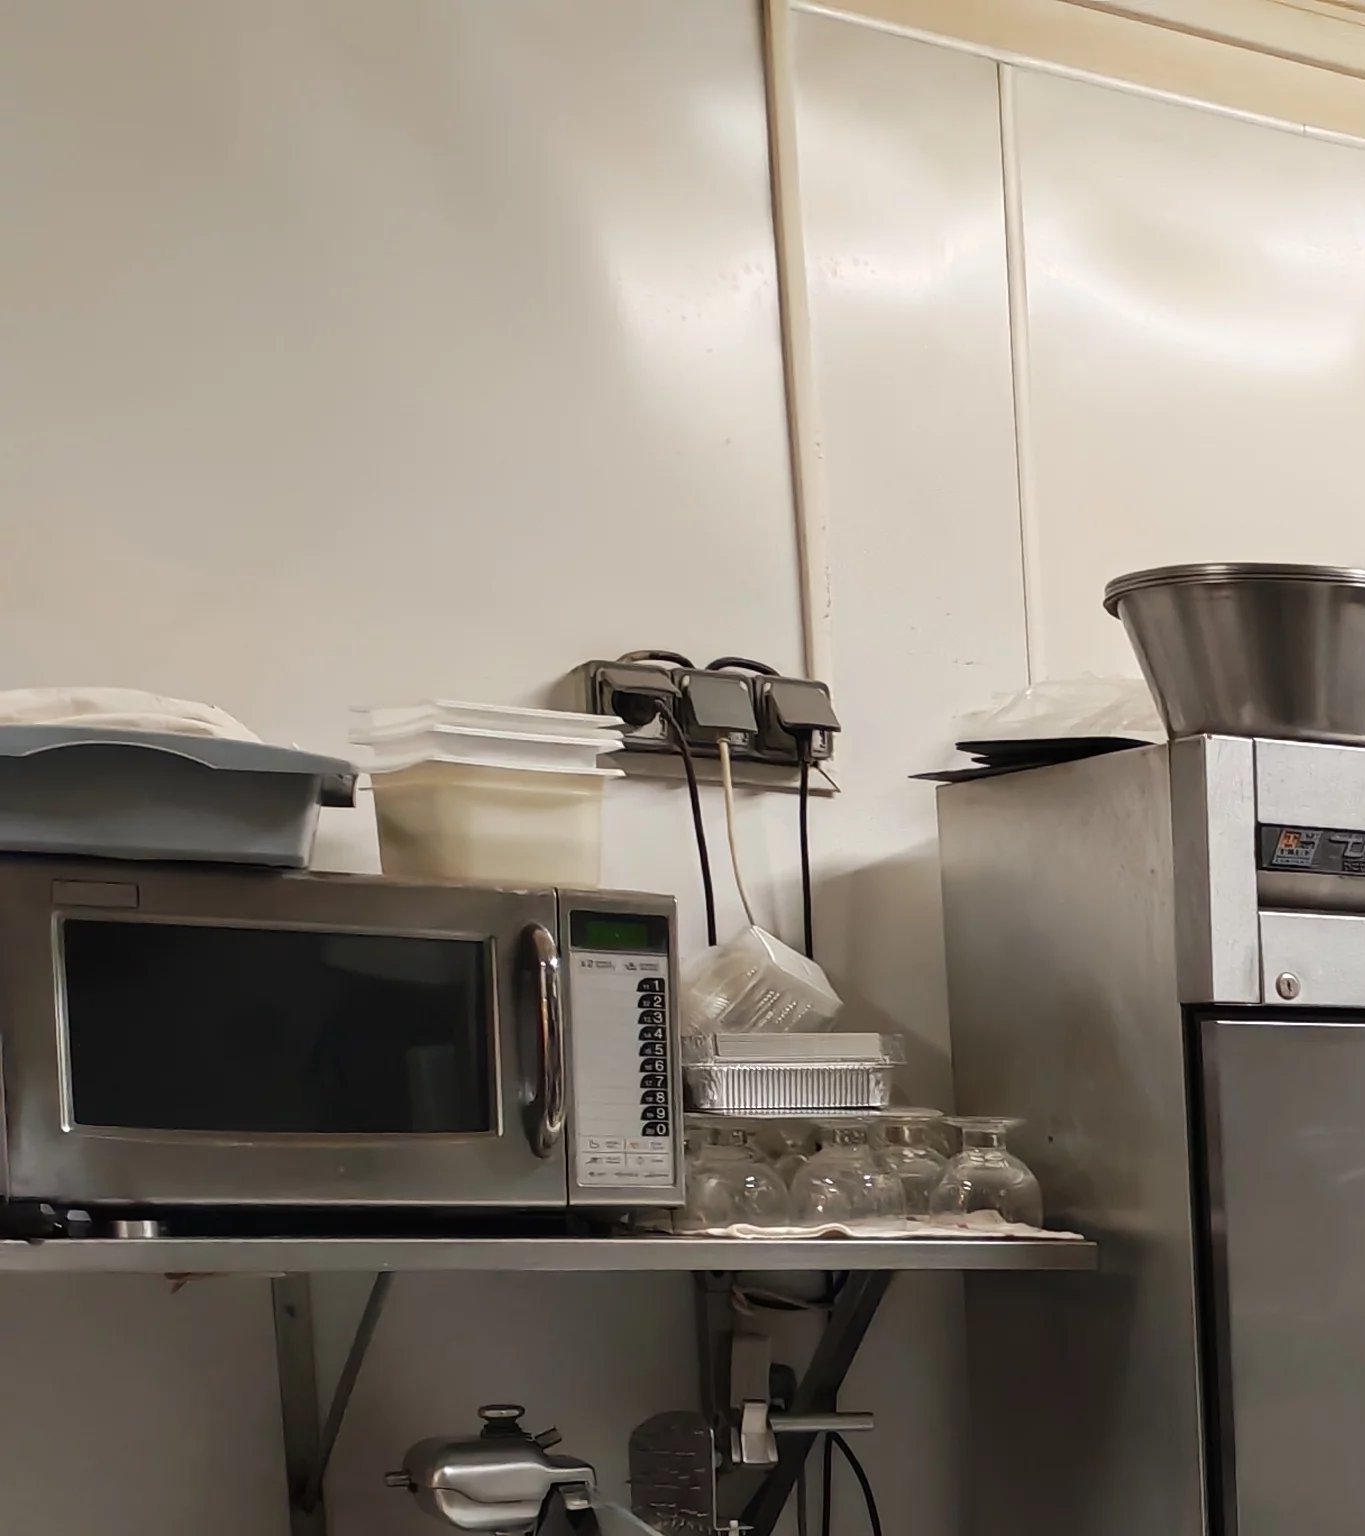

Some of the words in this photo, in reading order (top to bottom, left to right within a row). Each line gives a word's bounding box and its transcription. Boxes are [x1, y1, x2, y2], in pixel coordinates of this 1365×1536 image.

[653, 980, 660, 992] 1
[653, 995, 662, 1008] 2
[652, 1011, 664, 1024] 3
[653, 1028, 663, 1039] 4
[654, 1043, 664, 1056] 5
[655, 1060, 665, 1072] 6
[655, 1075, 665, 1087] 7
[656, 1091, 666, 1104] 8
[656, 1107, 666, 1119] 9
[656, 1123, 667, 1135] 0
